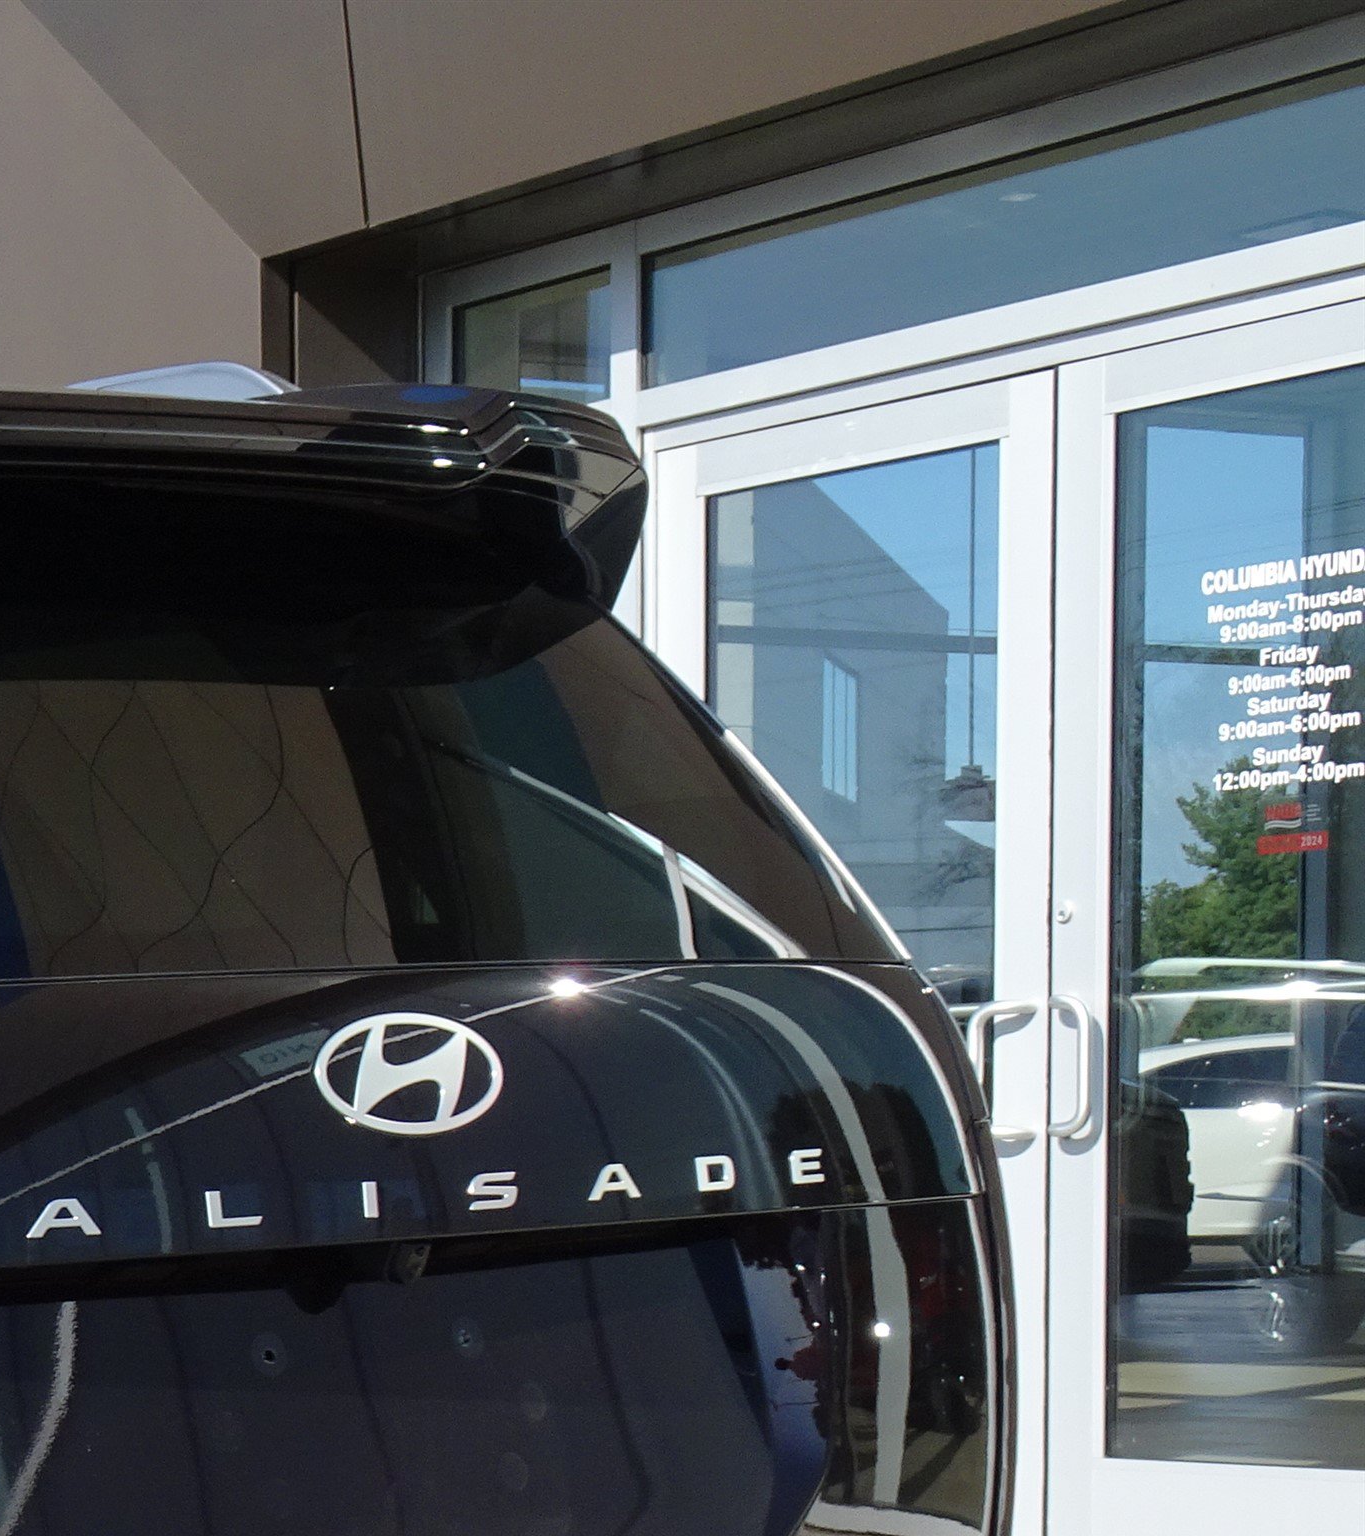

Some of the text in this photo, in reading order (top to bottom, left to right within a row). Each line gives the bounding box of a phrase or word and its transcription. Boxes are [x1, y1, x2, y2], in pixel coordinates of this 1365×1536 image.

[1201, 548, 1365, 596] COLUMBIA HYUND
[1207, 585, 1365, 624] Monday-Thursda
[1219, 610, 1363, 644] 9:00am-8:00pm
[1259, 644, 1319, 667] Friday
[1228, 664, 1351, 696] 9:00am-6:00pm
[1246, 691, 1332, 716] Saturday
[1218, 711, 1361, 742] 9:00am-6:00pm
[1252, 743, 1324, 766] Sunday
[1212, 761, 1365, 792] 12:00pm-4:00pm
[1300, 835, 1324, 848] 2024
